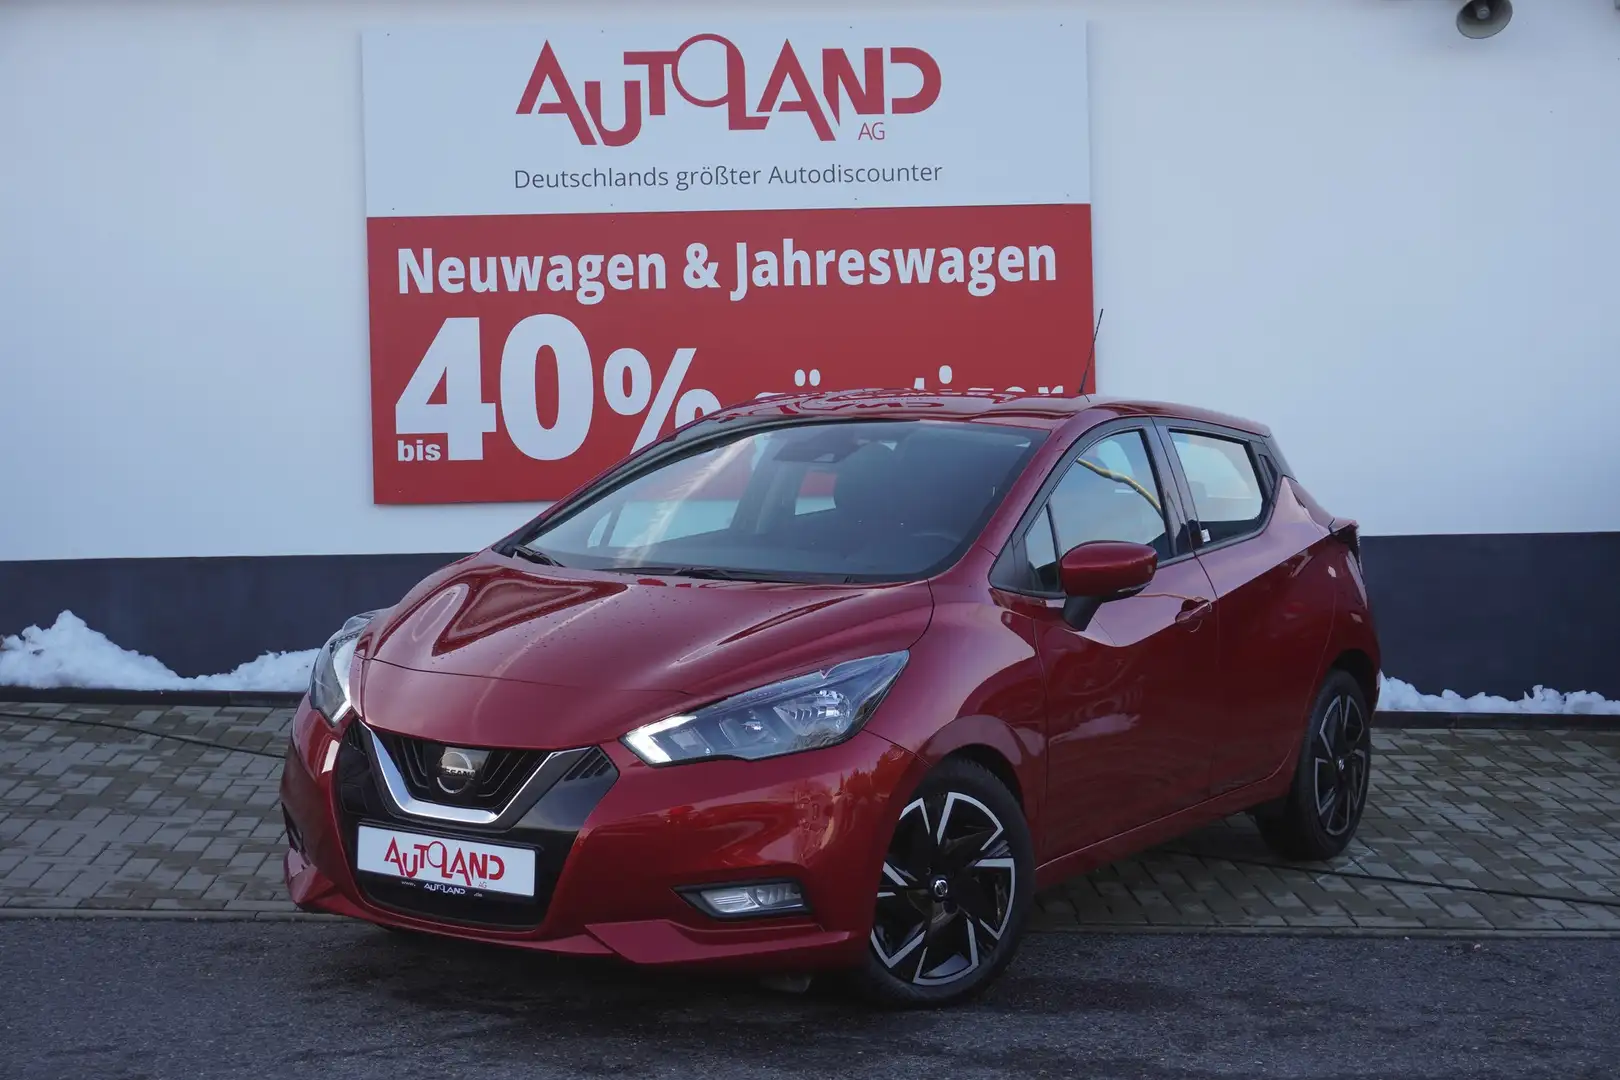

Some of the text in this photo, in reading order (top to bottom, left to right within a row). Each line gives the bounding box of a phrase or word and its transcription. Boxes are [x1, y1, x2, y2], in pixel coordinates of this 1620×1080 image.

[516, 33, 942, 146] AUTOLAND
[858, 122, 886, 141] AG
[514, 163, 943, 192] Deutschlands größter Autodiscounter
[397, 237, 1057, 305] Neuwagen & Jahreswagen
[395, 313, 724, 462] bis 40%
[384, 836, 505, 887] AUTOLAND
[424, 883, 466, 895] AUTOLAND
